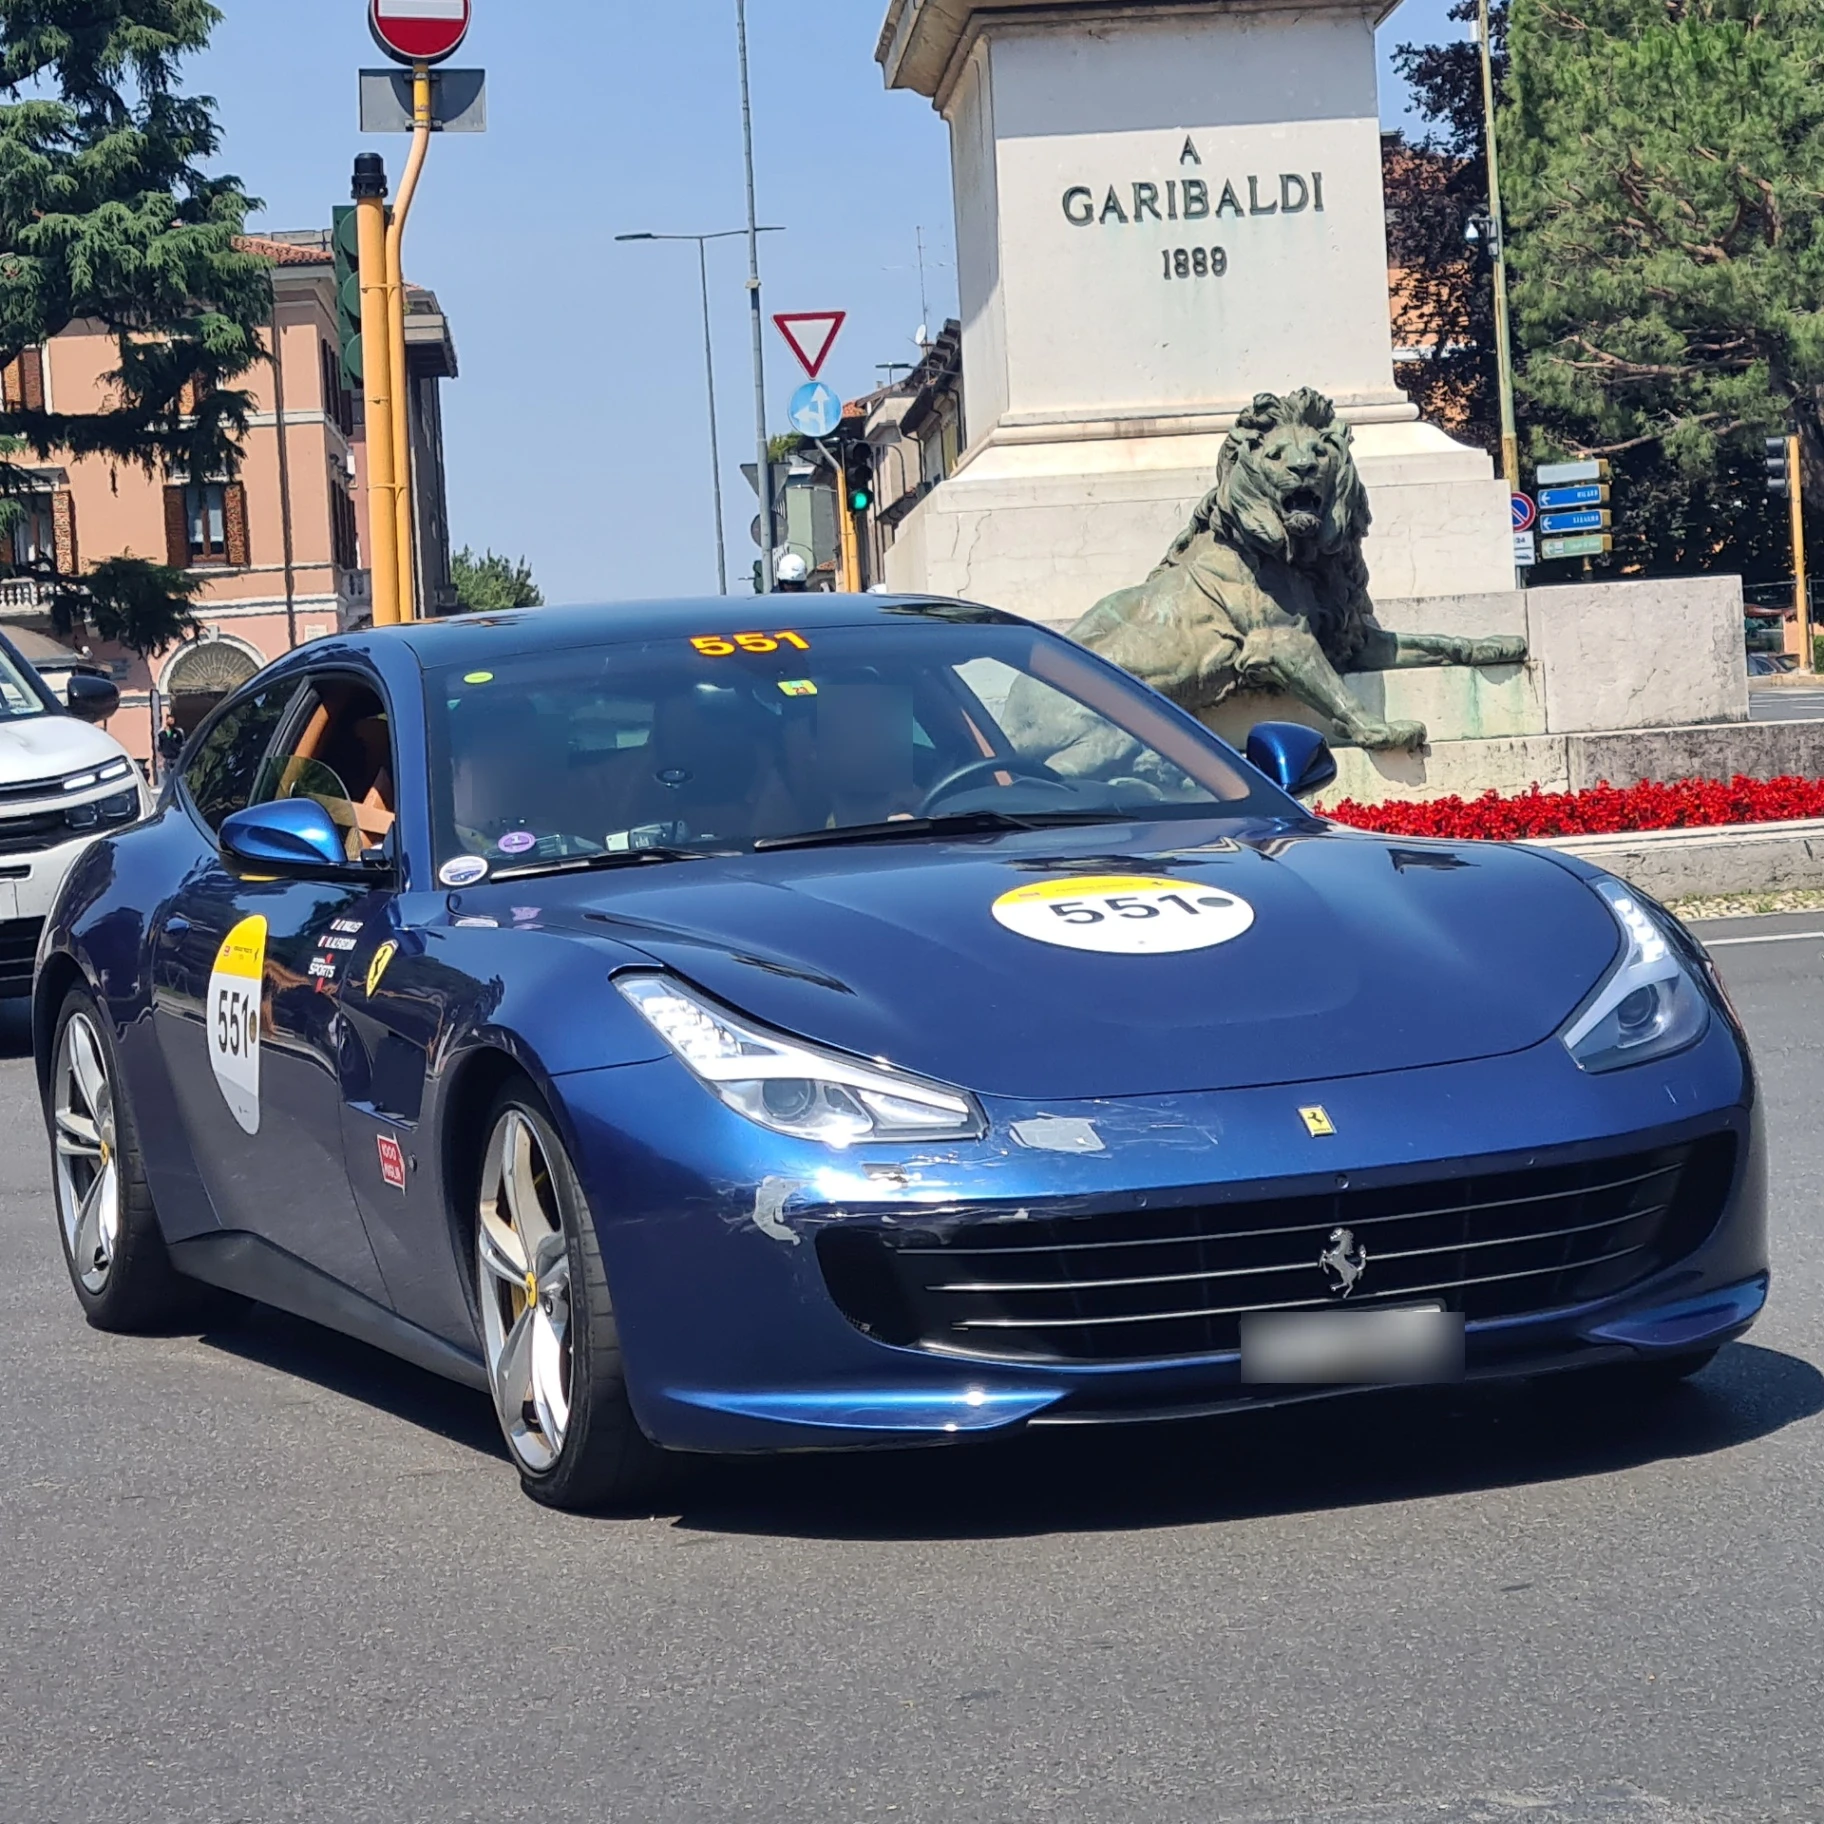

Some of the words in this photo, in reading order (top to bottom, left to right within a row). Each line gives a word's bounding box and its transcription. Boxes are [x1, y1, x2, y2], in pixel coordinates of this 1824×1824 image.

[1179, 134, 1202, 165] A
[1062, 172, 1325, 227] GARIBALDI
[689, 629, 811, 657] 551
[1049, 894, 1201, 925] 551
[217, 988, 249, 1058] 551
